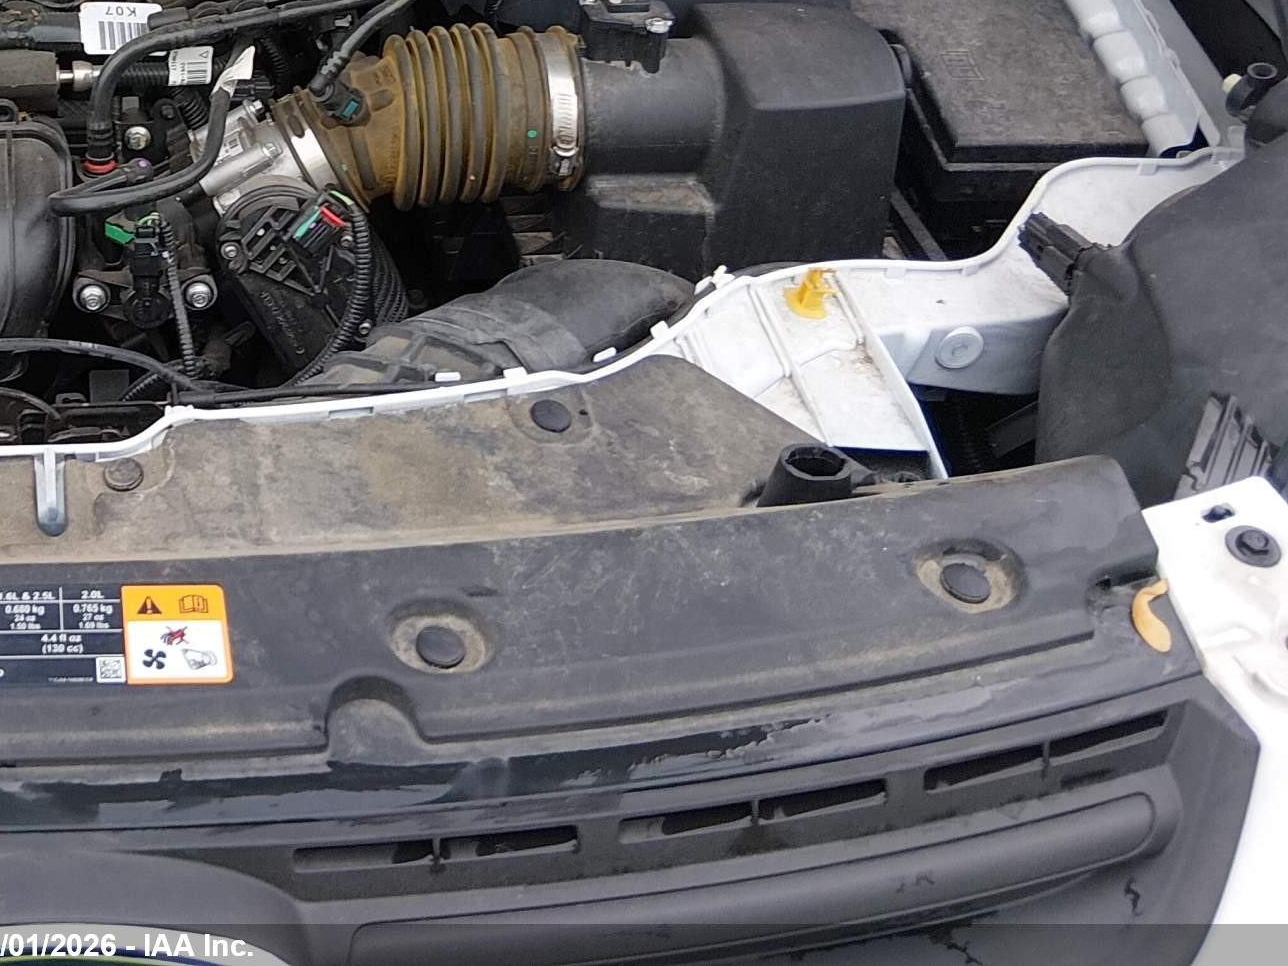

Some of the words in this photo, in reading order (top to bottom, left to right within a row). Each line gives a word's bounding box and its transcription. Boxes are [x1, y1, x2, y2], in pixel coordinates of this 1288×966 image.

[21, 591, 31, 600] &
[32, 591, 56, 600] 2.5L
[81, 590, 105, 599] 2.0L
[31, 605, 45, 615] kg
[72, 604, 98, 613] 0.765
[99, 604, 113, 614] kg
[27, 622, 41, 630] lbs
[96, 621, 110, 629] lbs
[40, 634, 57, 642] 4.4
[58, 633, 67, 642] fl
[68, 634, 82, 642] oz
[66, 644, 84, 653] cc)
